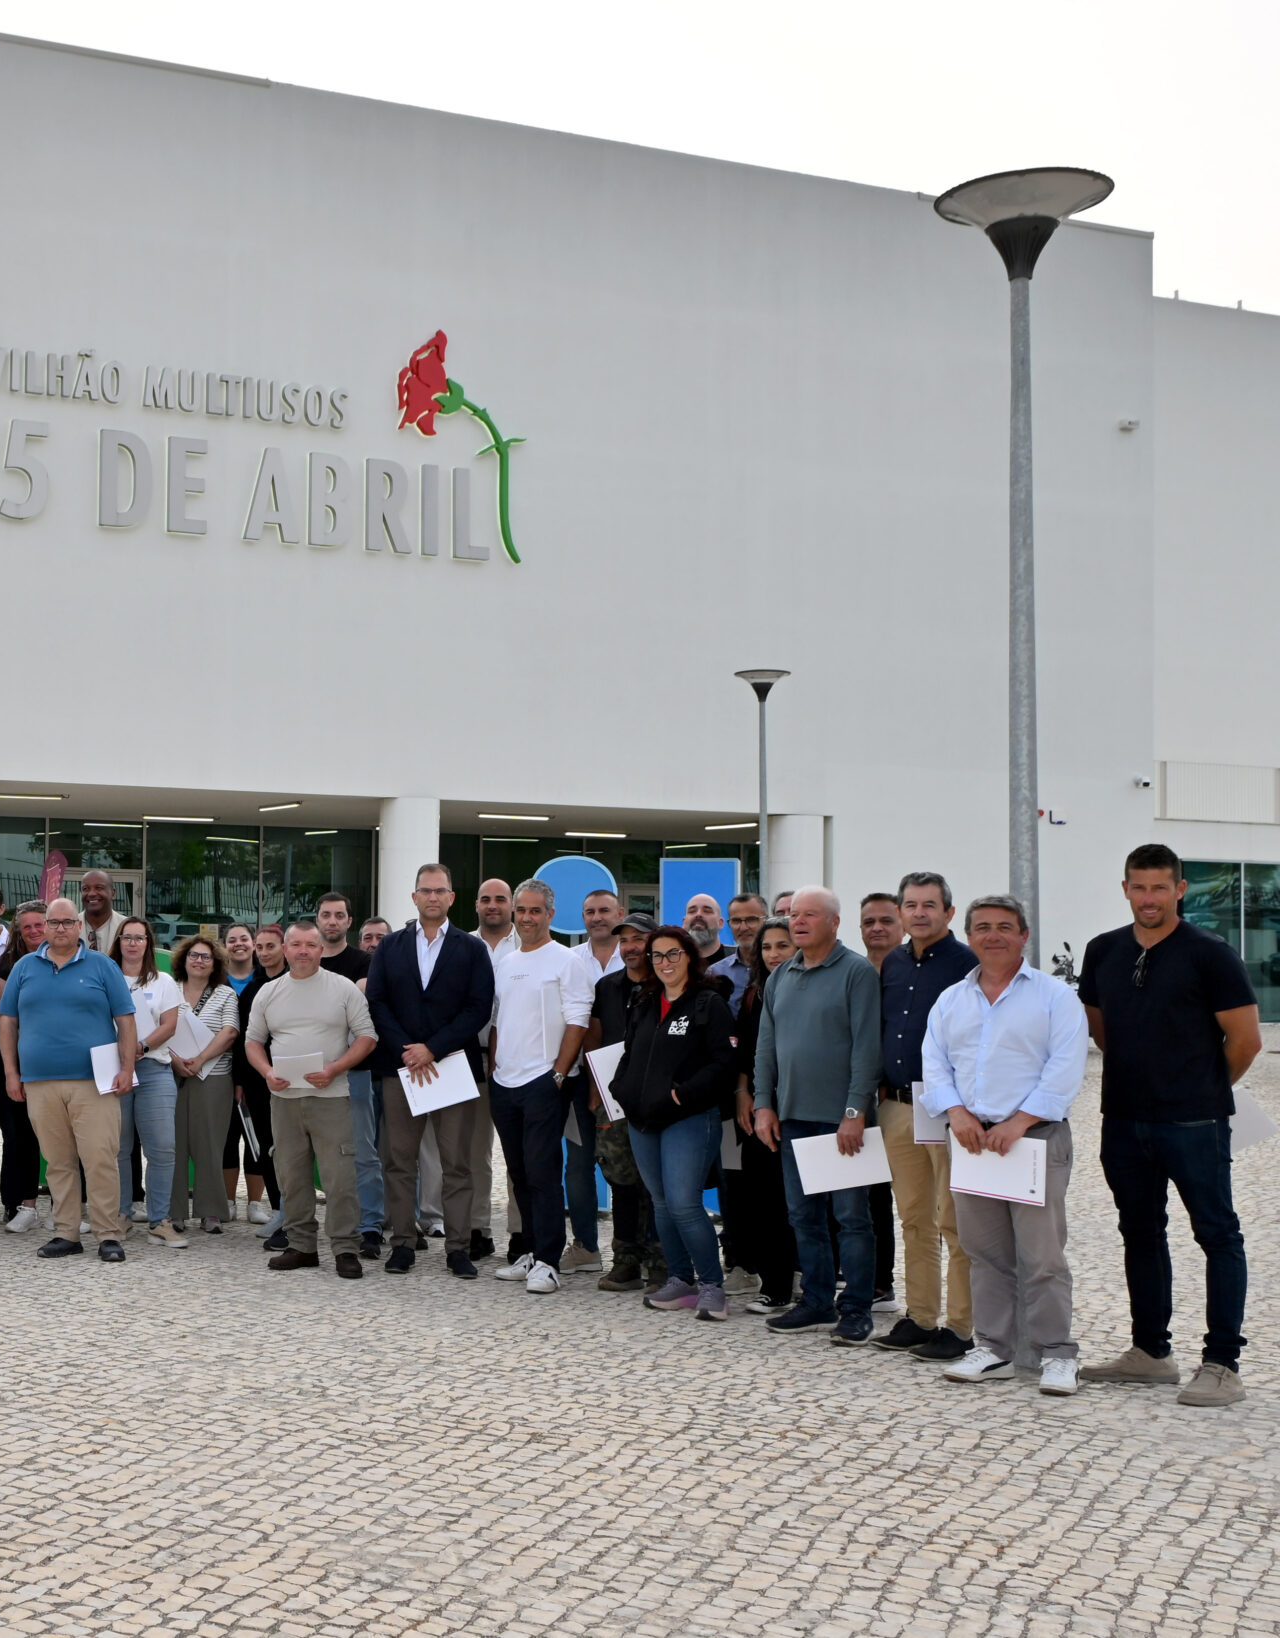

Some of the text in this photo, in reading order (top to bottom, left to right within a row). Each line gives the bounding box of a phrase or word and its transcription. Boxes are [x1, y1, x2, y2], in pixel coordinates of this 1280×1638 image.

[142, 366, 350, 430] MULTIUSOS
[98, 428, 209, 535] DE
[242, 446, 491, 562] ABRIL
